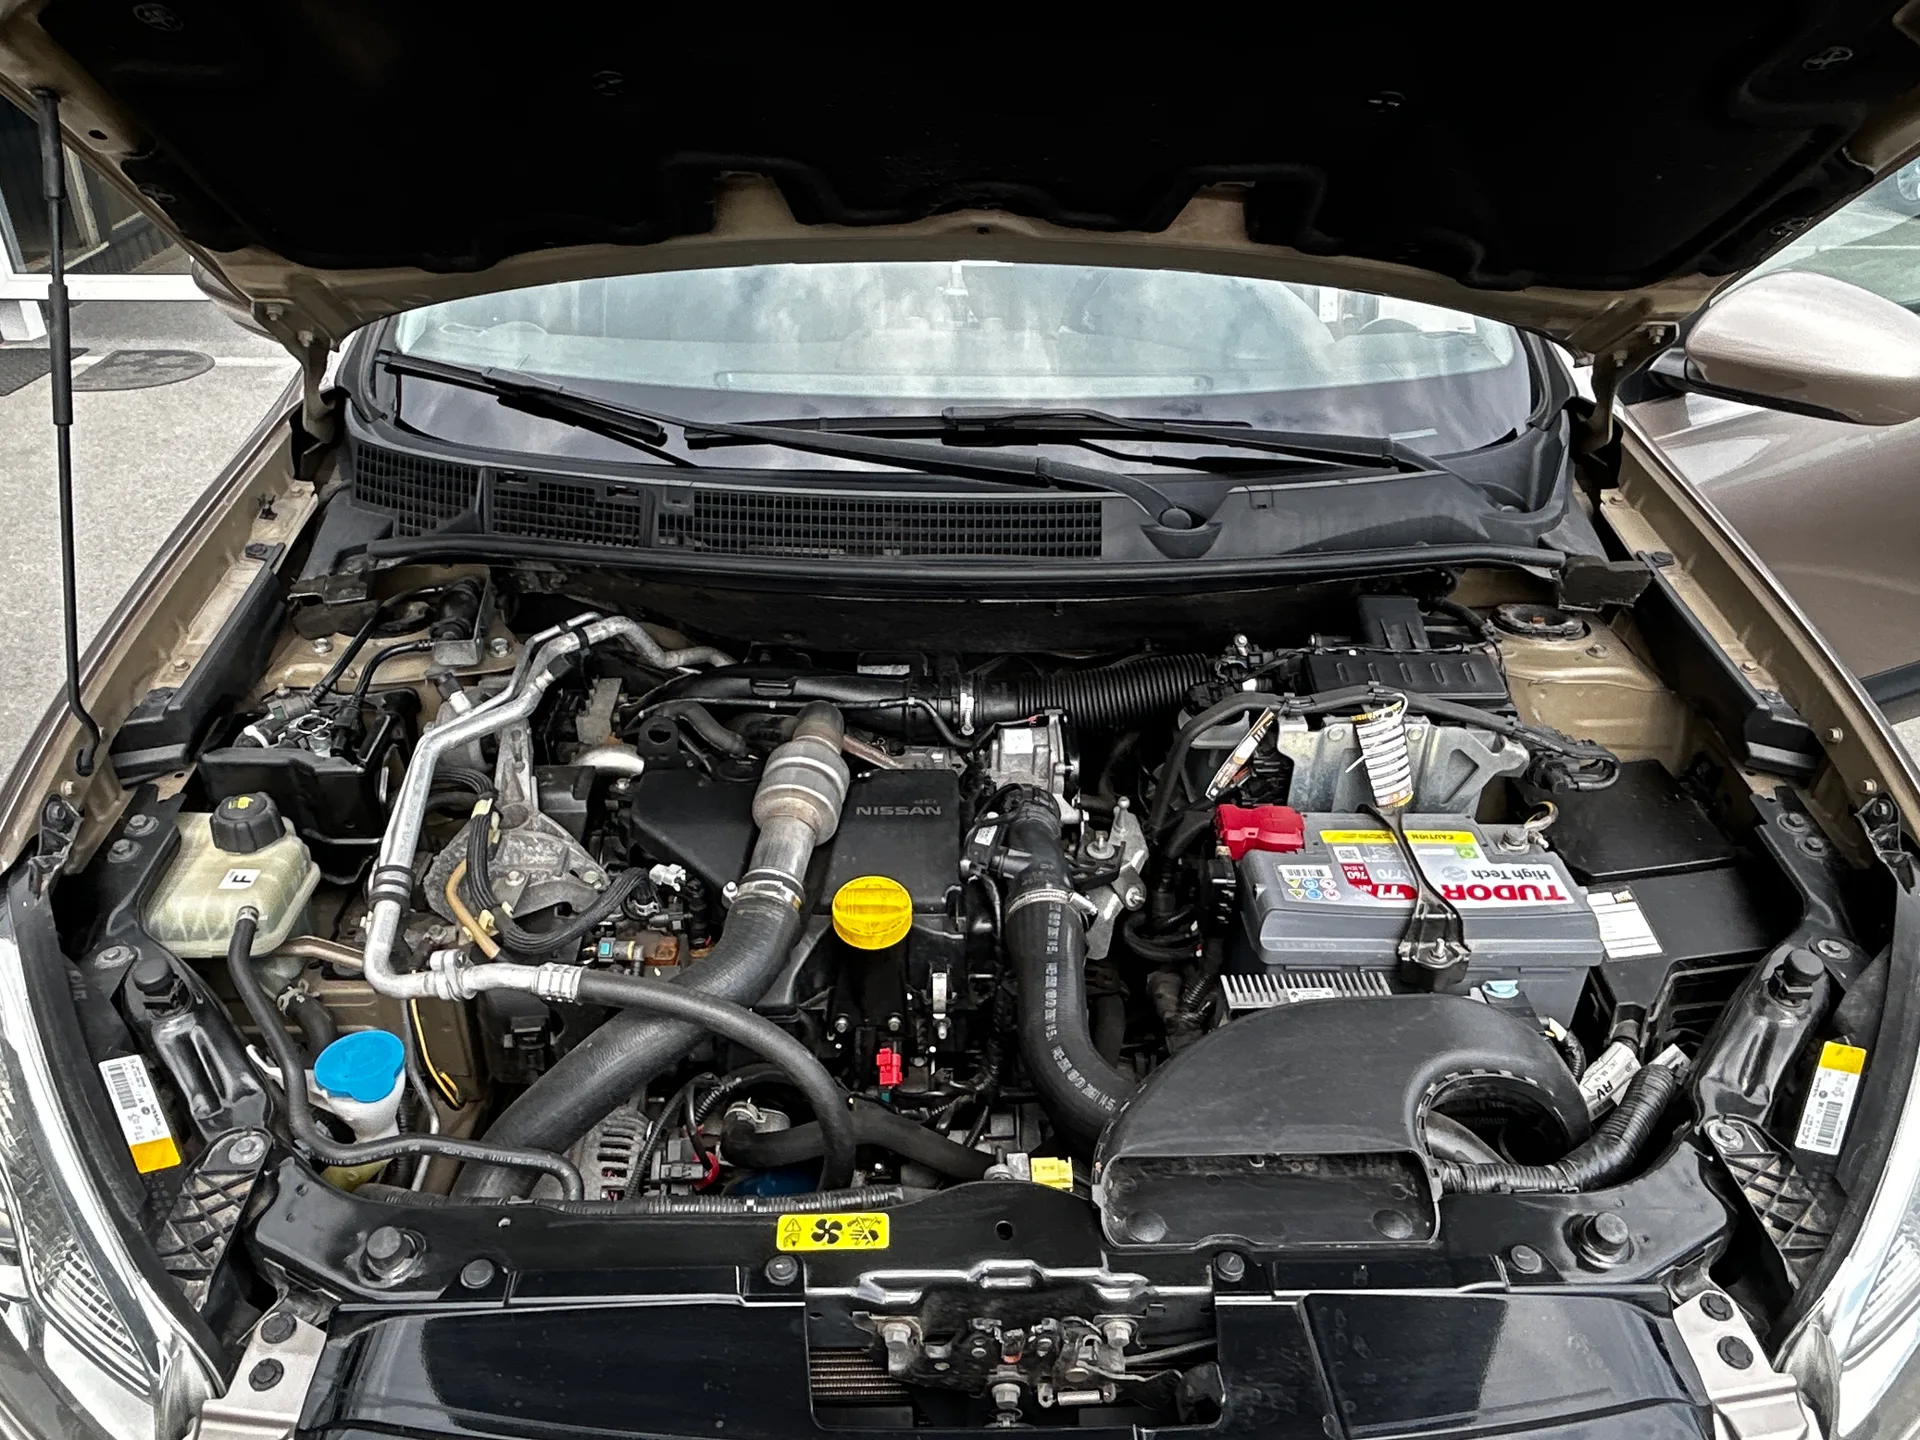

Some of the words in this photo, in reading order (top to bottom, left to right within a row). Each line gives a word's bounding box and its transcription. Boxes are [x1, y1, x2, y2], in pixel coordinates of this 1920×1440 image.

[856, 806, 941, 816] NISSAN
[1411, 833, 1454, 841] CAUTION
[231, 875, 252, 884] F
[1347, 871, 1368, 880] 760
[1471, 868, 1511, 881] Tech
[1511, 868, 1551, 881] High
[1377, 885, 1406, 899] 77
[1441, 884, 1566, 901] TUDOR
[1596, 1080, 1613, 1100] RV
